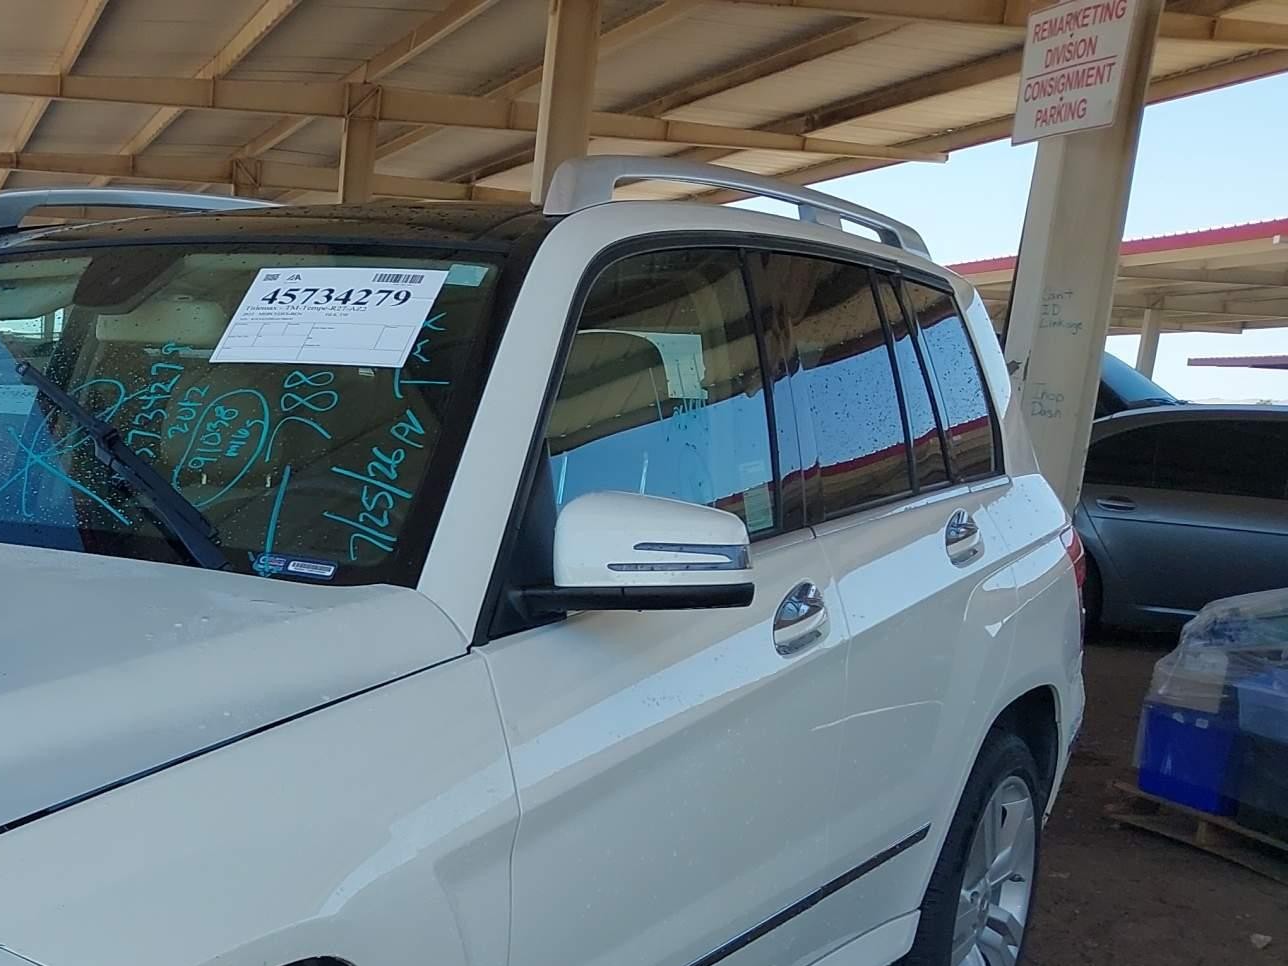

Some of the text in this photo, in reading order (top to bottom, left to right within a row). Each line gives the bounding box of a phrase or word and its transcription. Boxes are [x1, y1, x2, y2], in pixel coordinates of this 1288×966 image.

[1032, 0, 1127, 44] REMARKETING
[1044, 35, 1099, 69] DIVISION
[1024, 62, 1116, 103] CONSIGNMENT
[1034, 98, 1088, 129] PARKING
[260, 287, 412, 307] 45734279
